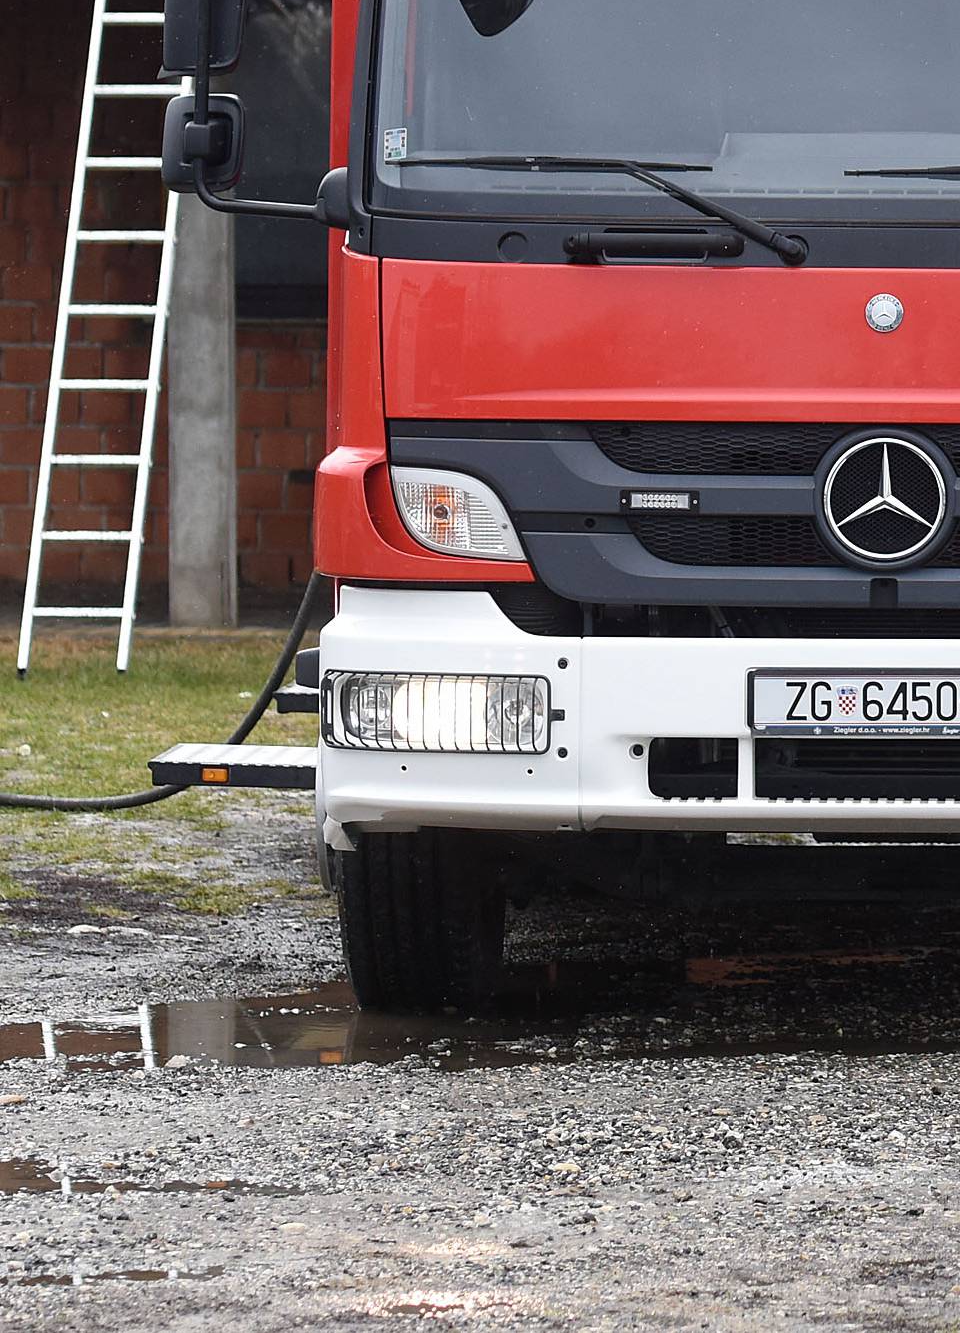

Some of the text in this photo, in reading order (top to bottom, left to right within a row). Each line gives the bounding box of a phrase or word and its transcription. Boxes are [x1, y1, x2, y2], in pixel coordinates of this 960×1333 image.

[786, 681, 832, 722] ZG
[833, 725, 856, 735] Ziegler
[882, 725, 931, 735] www.ziegler.hr
